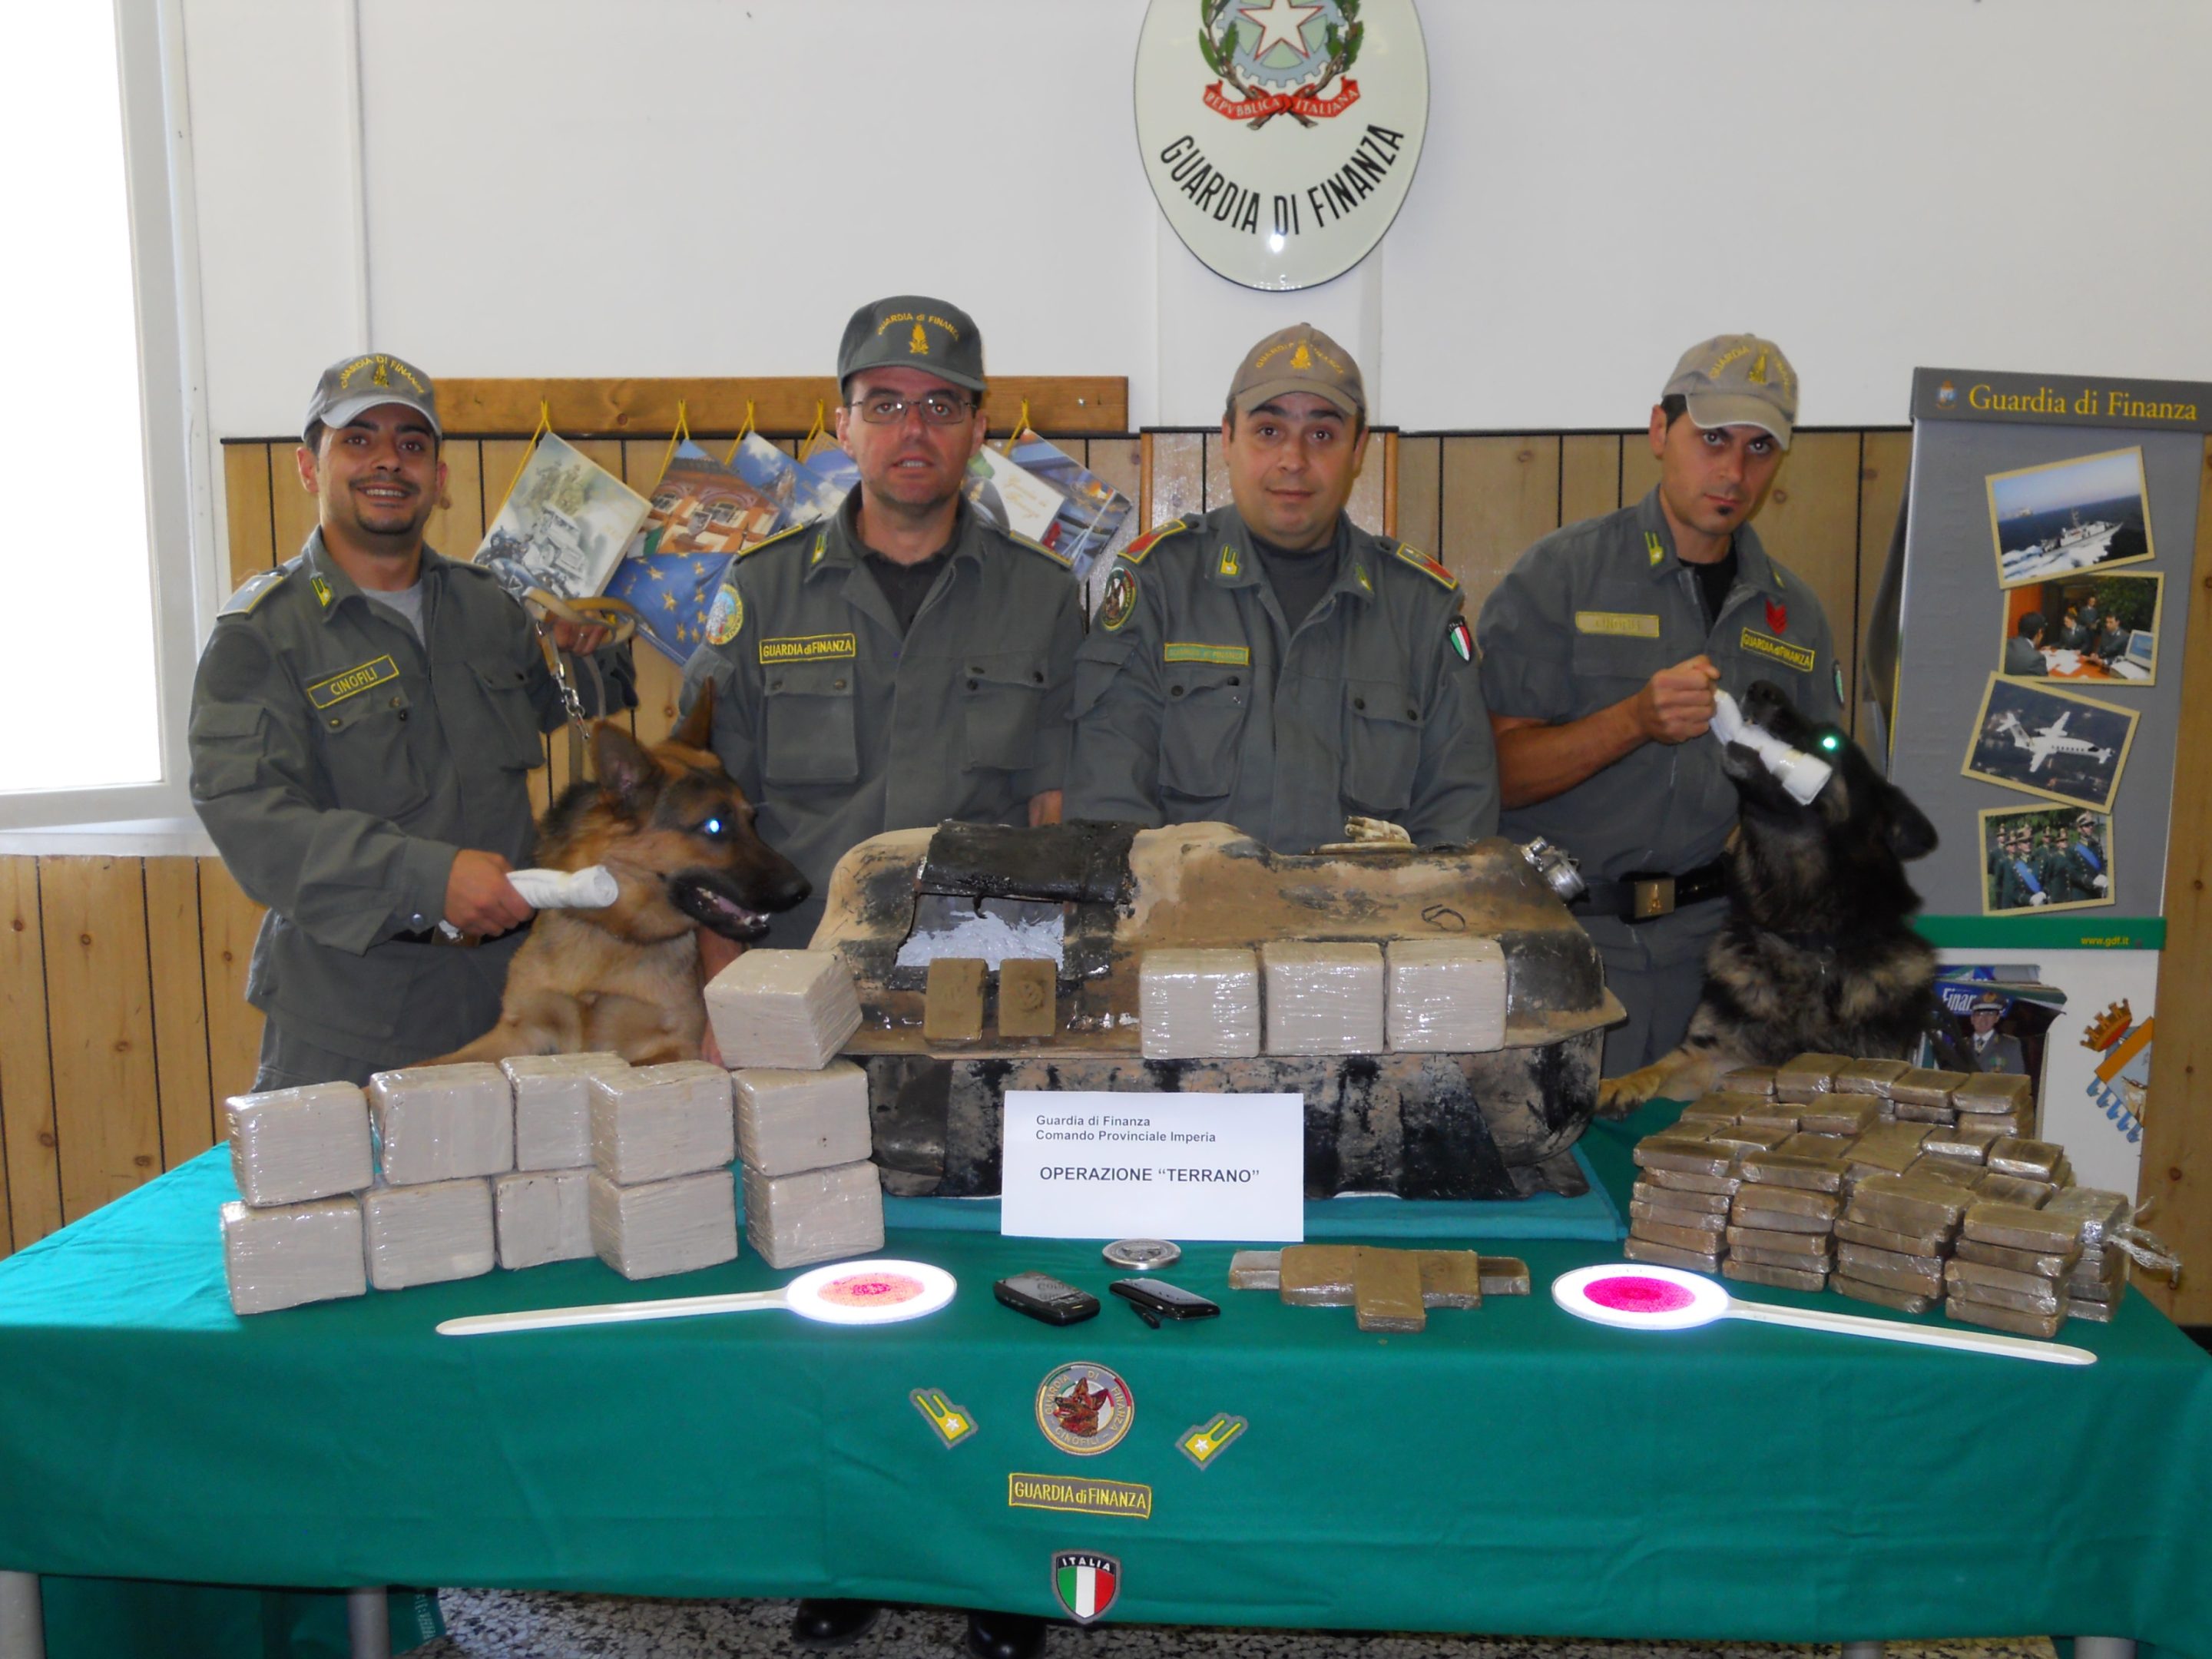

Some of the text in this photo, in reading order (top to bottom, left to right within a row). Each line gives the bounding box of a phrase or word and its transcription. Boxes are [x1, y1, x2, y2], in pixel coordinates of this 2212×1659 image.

[1296, 89, 1358, 113] ITALIANA
[1161, 124, 1404, 236] GUARDIA DI FINANZA
[1969, 383, 2197, 420] Guardia di Finanza
[763, 643, 803, 657] GUARDIA
[812, 640, 852, 653] FINANZA
[330, 666, 378, 695] CINOFILI
[2081, 935, 2129, 947] www.gdf.it
[1036, 1114, 1151, 1127] Guardia di Finanza
[1035, 1130, 1216, 1144] Comando Provinciale Imperia
[1040, 1167, 1260, 1183] OPERAZIONE “TERRANO”
[1045, 1370, 1125, 1431] GUARDIA DI FINANZA
[1056, 1427, 1100, 1445] CINOFILI
[1014, 1481, 1147, 1509] GUARDIA di FINANZA
[1062, 1555, 1111, 1571] ITALIA
